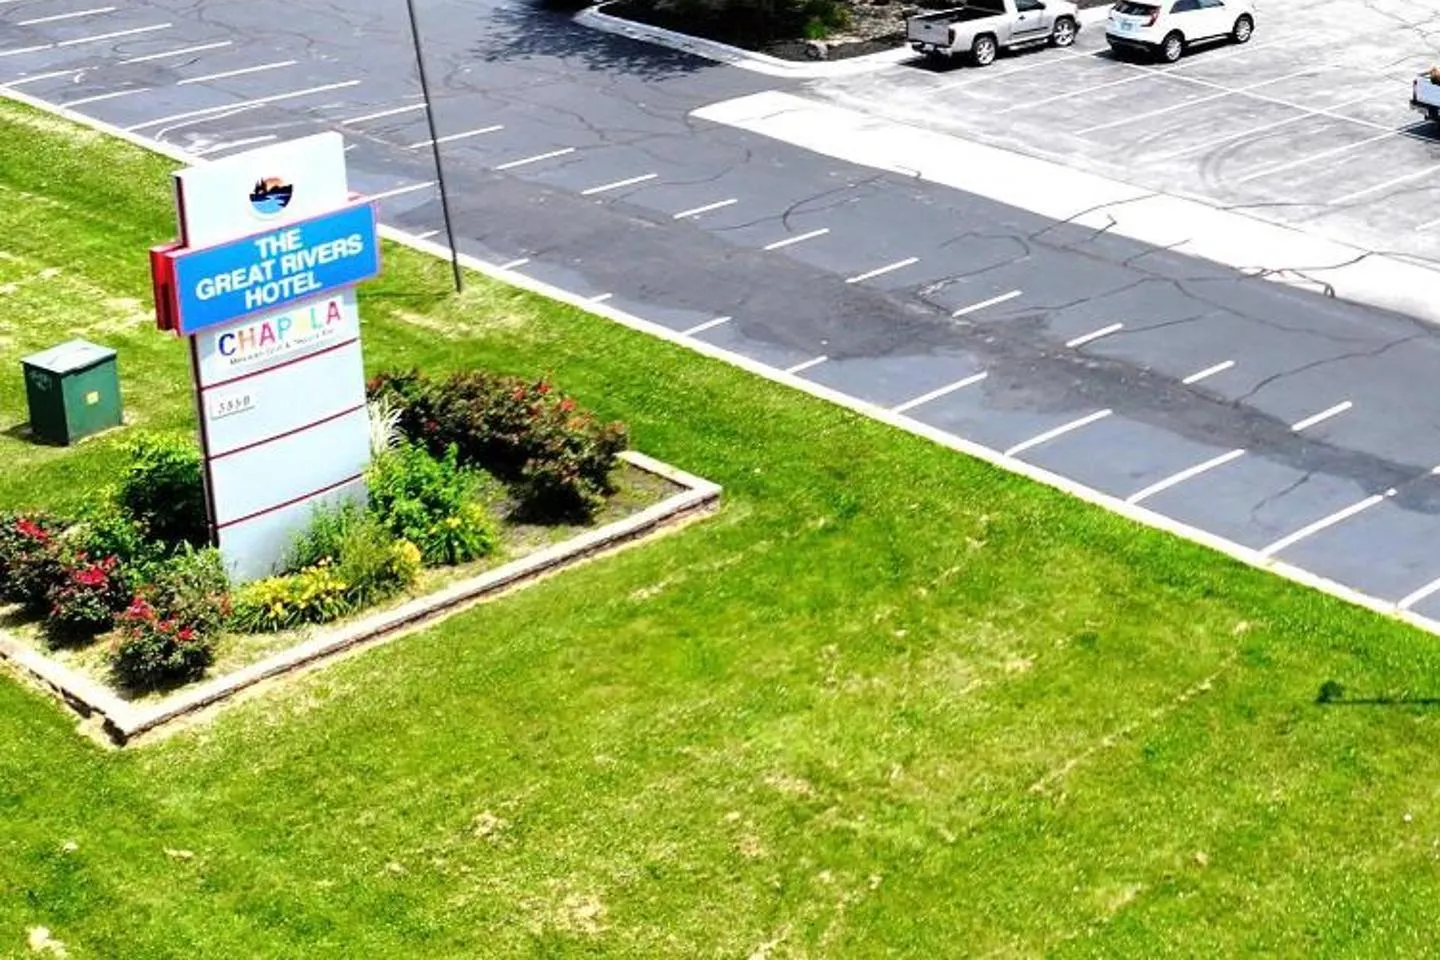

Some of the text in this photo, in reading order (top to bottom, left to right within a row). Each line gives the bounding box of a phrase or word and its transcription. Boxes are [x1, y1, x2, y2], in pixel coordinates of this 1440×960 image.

[254, 228, 303, 259] THE
[195, 234, 364, 301] GREAT RIVERS
[245, 271, 323, 310] HOTEL
[218, 300, 342, 356] CHAPLA
